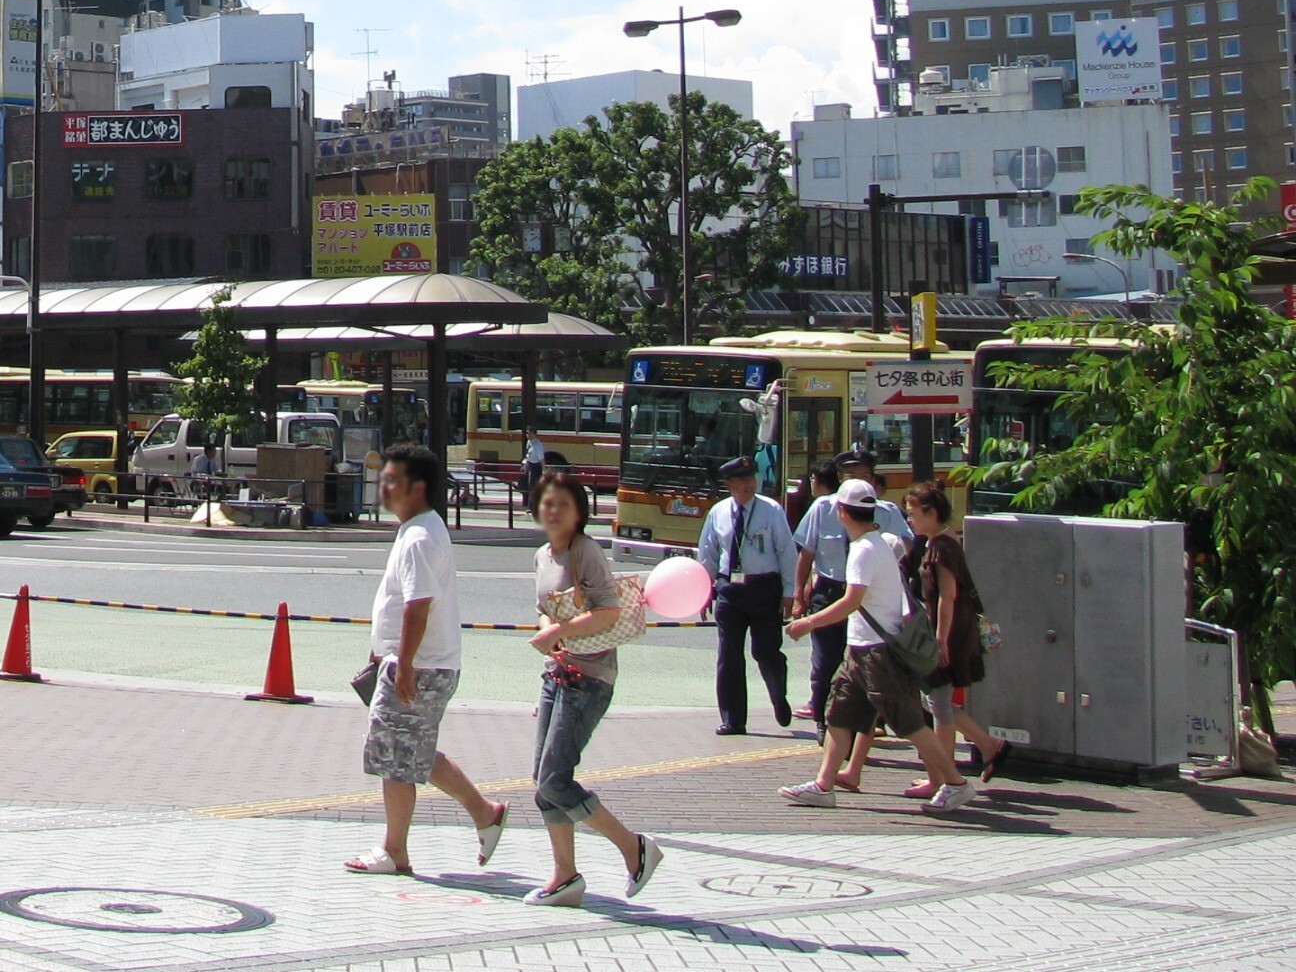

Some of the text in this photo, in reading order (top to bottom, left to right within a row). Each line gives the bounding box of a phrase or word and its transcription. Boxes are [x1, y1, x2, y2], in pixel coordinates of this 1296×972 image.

[1128, 61, 1155, 69] House
[1107, 73, 1130, 81] Group
[318, 201, 432, 223] 賃貸 ユーミーらいふ
[317, 228, 369, 240] マンション
[373, 222, 432, 238] 平塚駅前店
[777, 255, 847, 276] みずほ銀行
[875, 370, 964, 387] 七夕祭中心街
